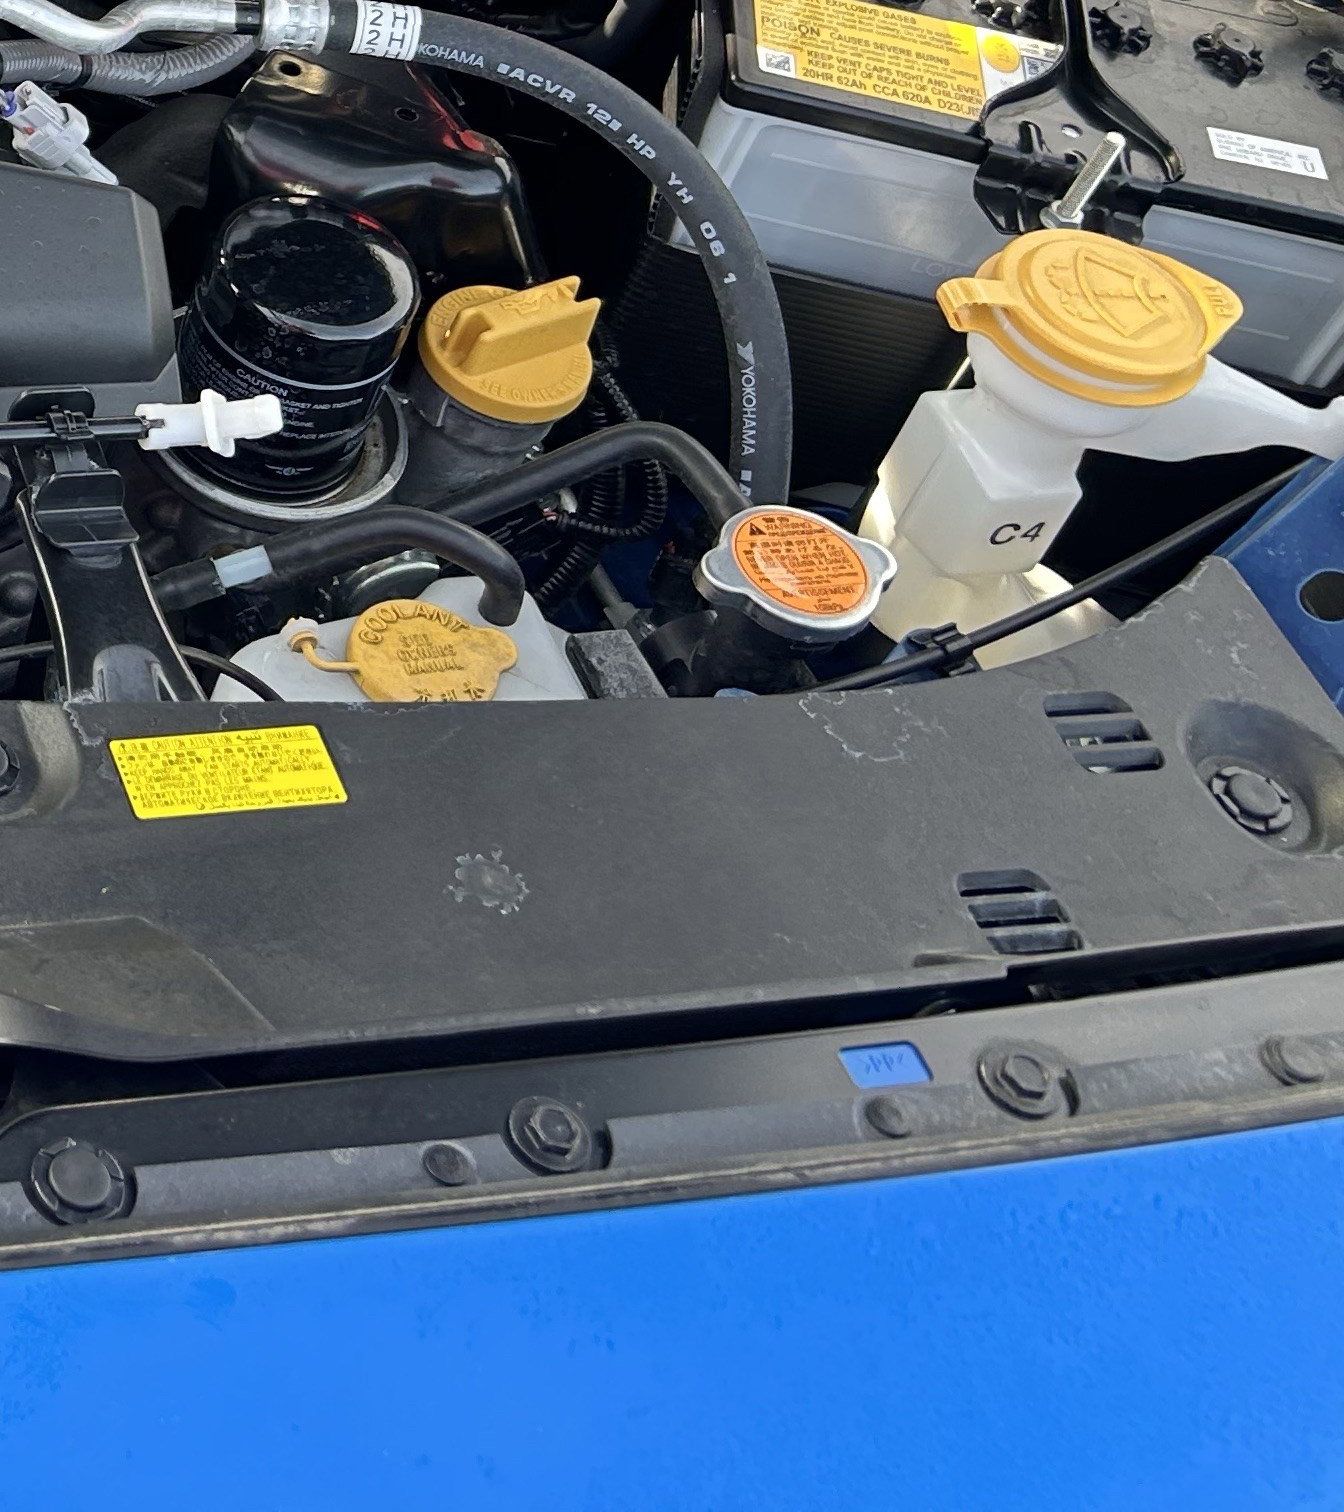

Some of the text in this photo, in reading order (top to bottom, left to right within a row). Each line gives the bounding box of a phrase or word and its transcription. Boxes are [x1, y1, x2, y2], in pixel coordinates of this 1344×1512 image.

[882, 11, 916, 24] GASES
[761, 15, 820, 36] POISON
[830, 32, 870, 48] CAUSES
[873, 42, 912, 57] SEVERE
[915, 51, 949, 66] BURNS
[801, 66, 833, 82] 20HR
[836, 74, 866, 90] 62Ah
[872, 83, 900, 98] CCA
[902, 90, 931, 105] 620A
[807, 50, 981, 96] KEEP VENT CAPS TIGHT AND LEVEL
[808, 58, 982, 105] KEEP OUT OF REACH OF CHILDREN
[417, 42, 485, 69] KOHAMA
[509, 67, 576, 104] ACVR
[586, 103, 611, 125] 12
[626, 133, 656, 160] HP
[667, 171, 694, 204] YH
[700, 221, 725, 257] 06
[740, 365, 757, 457] YOKOHAMA
[431, 289, 477, 327] ENGIN
[237, 368, 288, 397] CAUTION
[990, 522, 1046, 545] C4
[358, 604, 470, 645] COOLANT
[151, 738, 185, 749] CAUTION
[188, 734, 232, 746] ATTENTION
